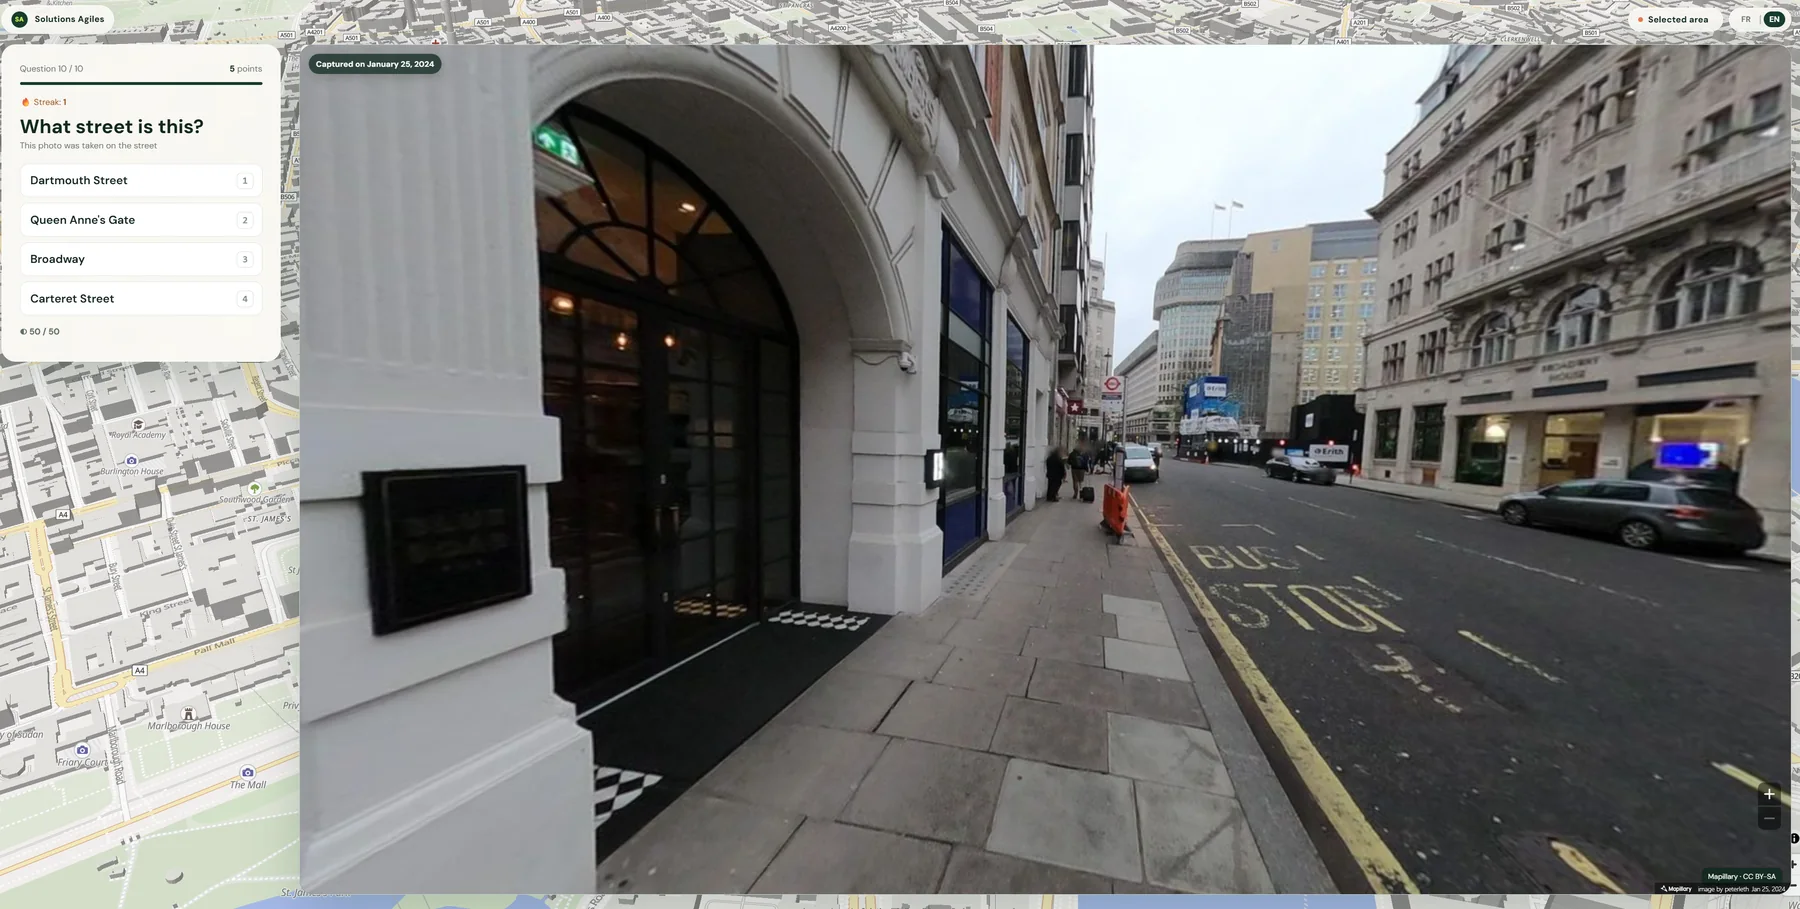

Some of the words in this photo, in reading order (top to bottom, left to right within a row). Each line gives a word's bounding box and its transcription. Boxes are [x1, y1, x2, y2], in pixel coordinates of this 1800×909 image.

[111, 431, 131, 441] Royal
[134, 431, 166, 441] Academy
[100, 467, 139, 476] Burlington
[140, 467, 164, 475] House
[219, 495, 262, 503] Southwood
[263, 495, 291, 503] Garden
[247, 515, 259, 523] ST.
[260, 515, 292, 523] JAMES'S
[1190, 545, 1299, 570] BUS
[140, 607, 161, 620] King
[164, 597, 193, 610] Street
[1209, 583, 1405, 632] STOP
[194, 644, 212, 656] Pall
[215, 638, 236, 650] Mall
[148, 721, 203, 732] Marlborough
[204, 721, 231, 730] House
[17, 731, 44, 739] Sudan
[107, 725, 123, 767] Marlborough
[57, 758, 83, 769] Friary
[84, 758, 109, 767] Court
[113, 766, 125, 785] Road
[230, 780, 246, 789] The
[247, 780, 267, 789] Mall
